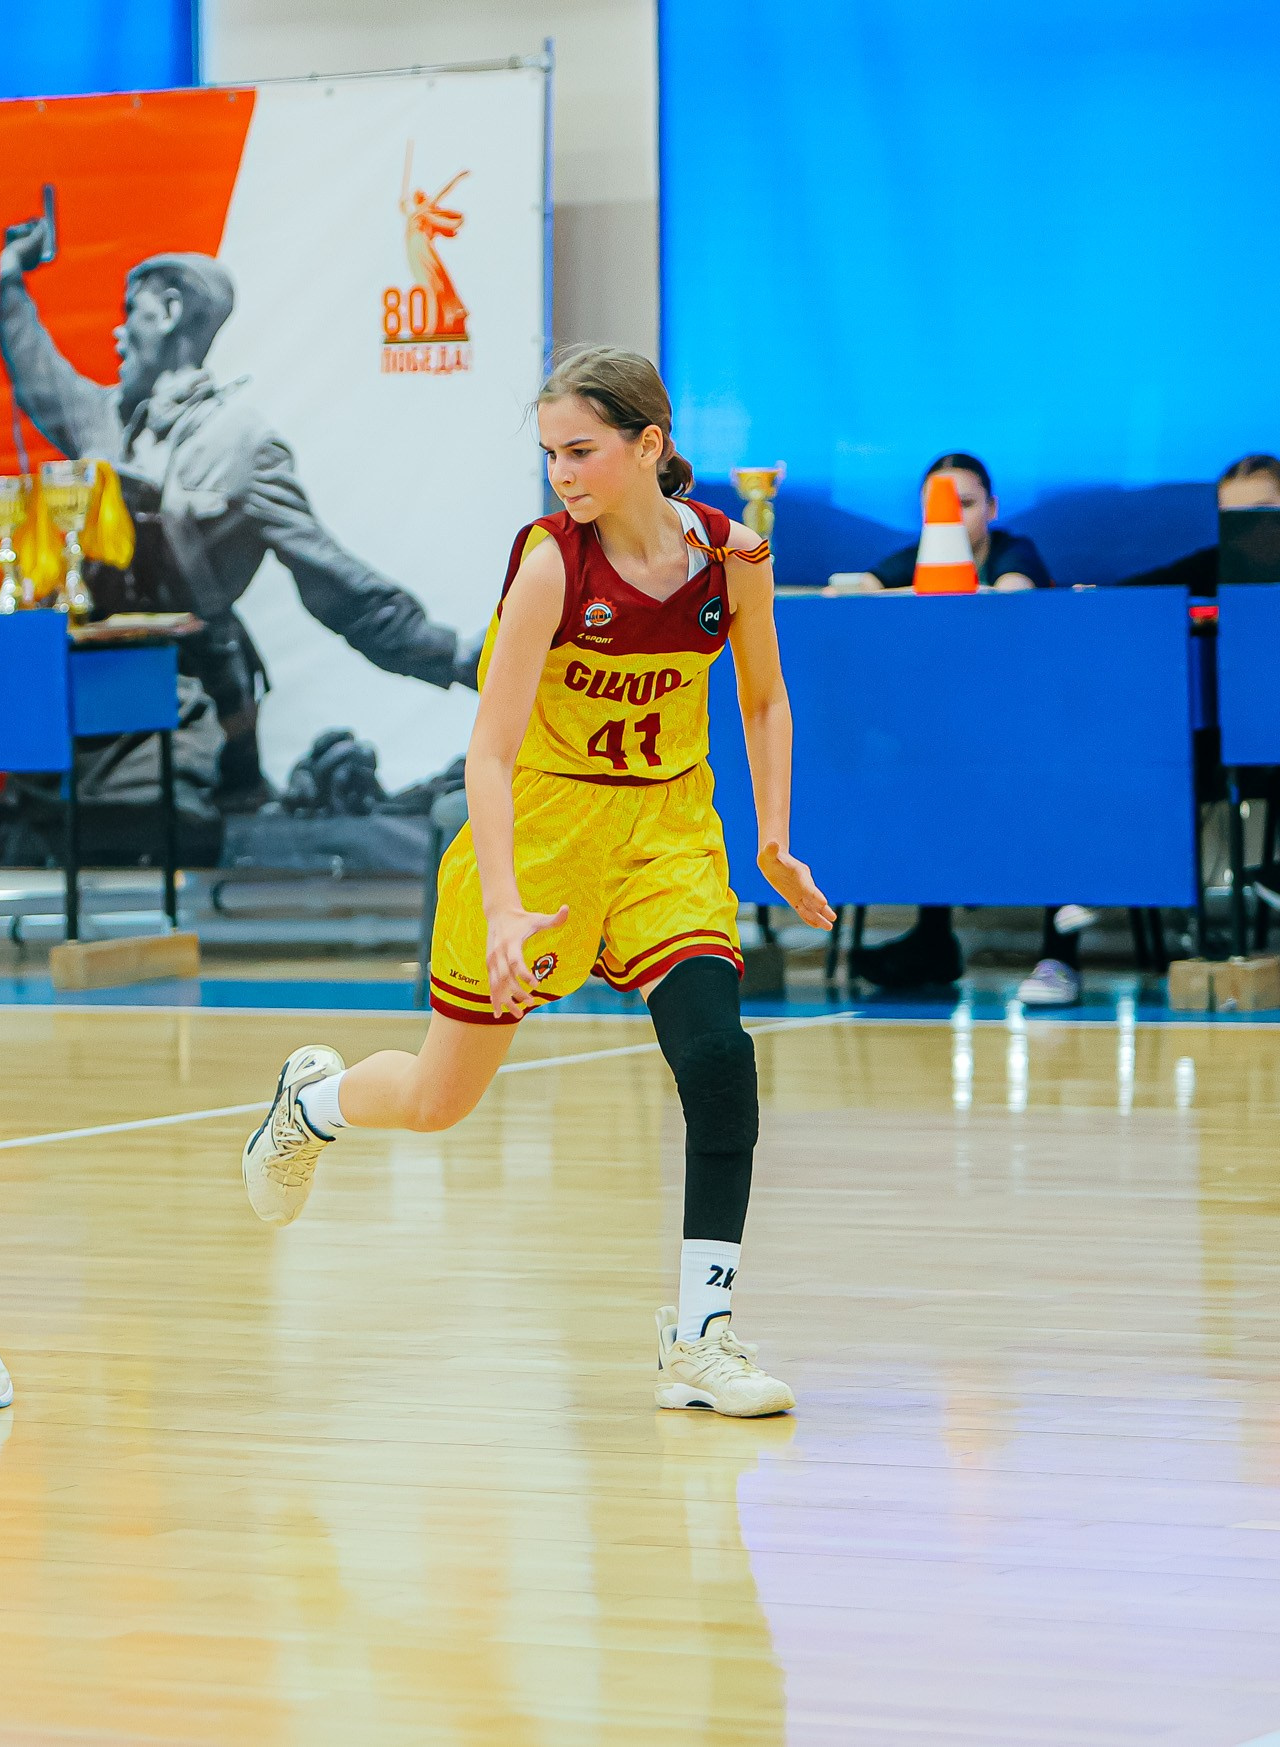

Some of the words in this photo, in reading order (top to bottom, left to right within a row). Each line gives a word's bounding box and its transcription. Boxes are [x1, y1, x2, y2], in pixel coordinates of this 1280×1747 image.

[382, 286, 428, 338] 80
[587, 712, 662, 770] 41
[458, 973, 480, 985] SPORT
